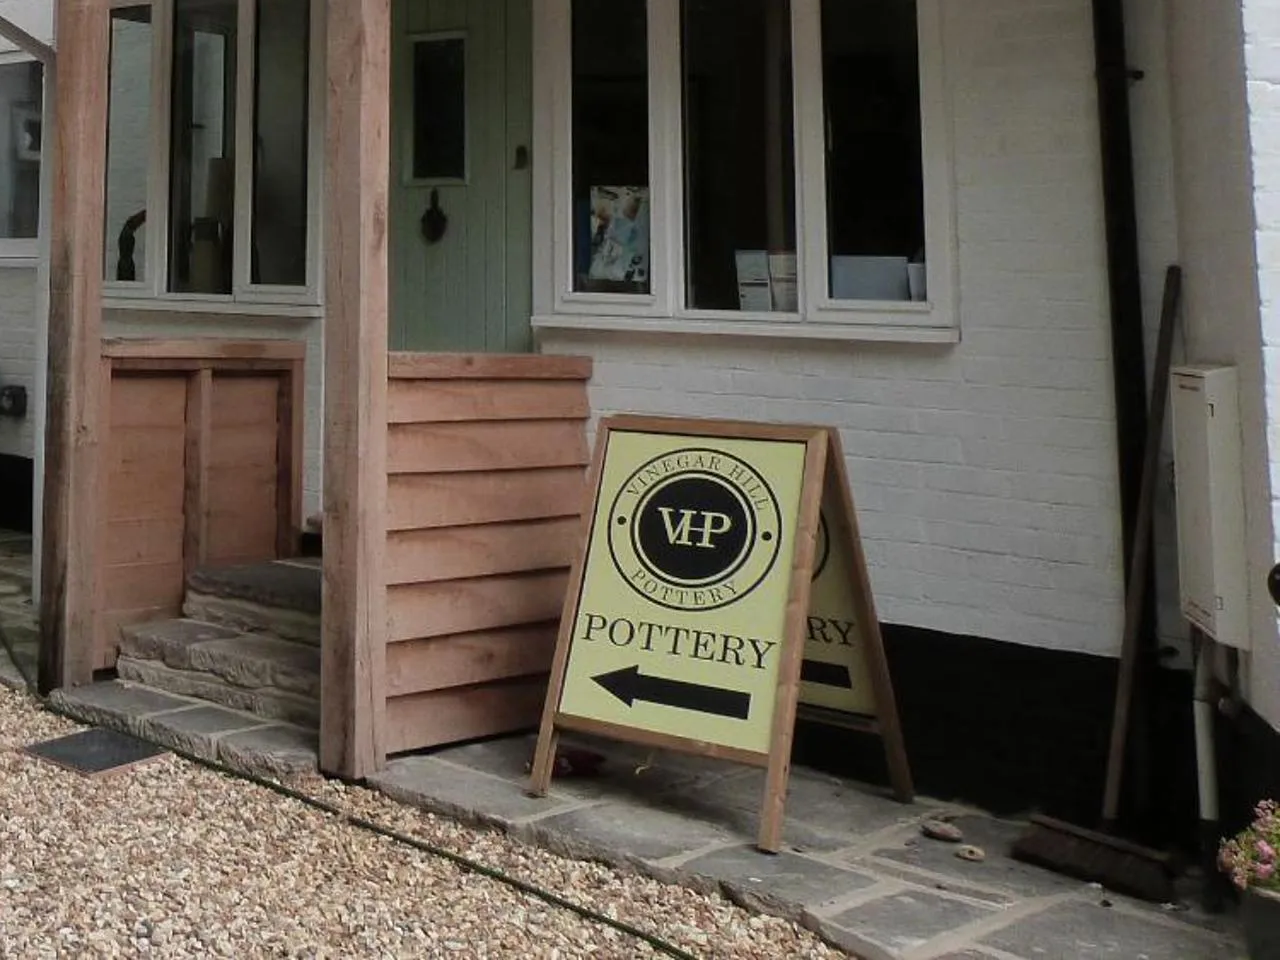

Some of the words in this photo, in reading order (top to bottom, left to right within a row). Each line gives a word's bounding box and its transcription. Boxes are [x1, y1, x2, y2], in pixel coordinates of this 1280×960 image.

[627, 454, 721, 498] VINEGAR
[728, 464, 770, 511] HILL
[657, 506, 733, 549] VHP
[631, 567, 738, 606] POTTERY
[581, 612, 777, 670] POTTERY
